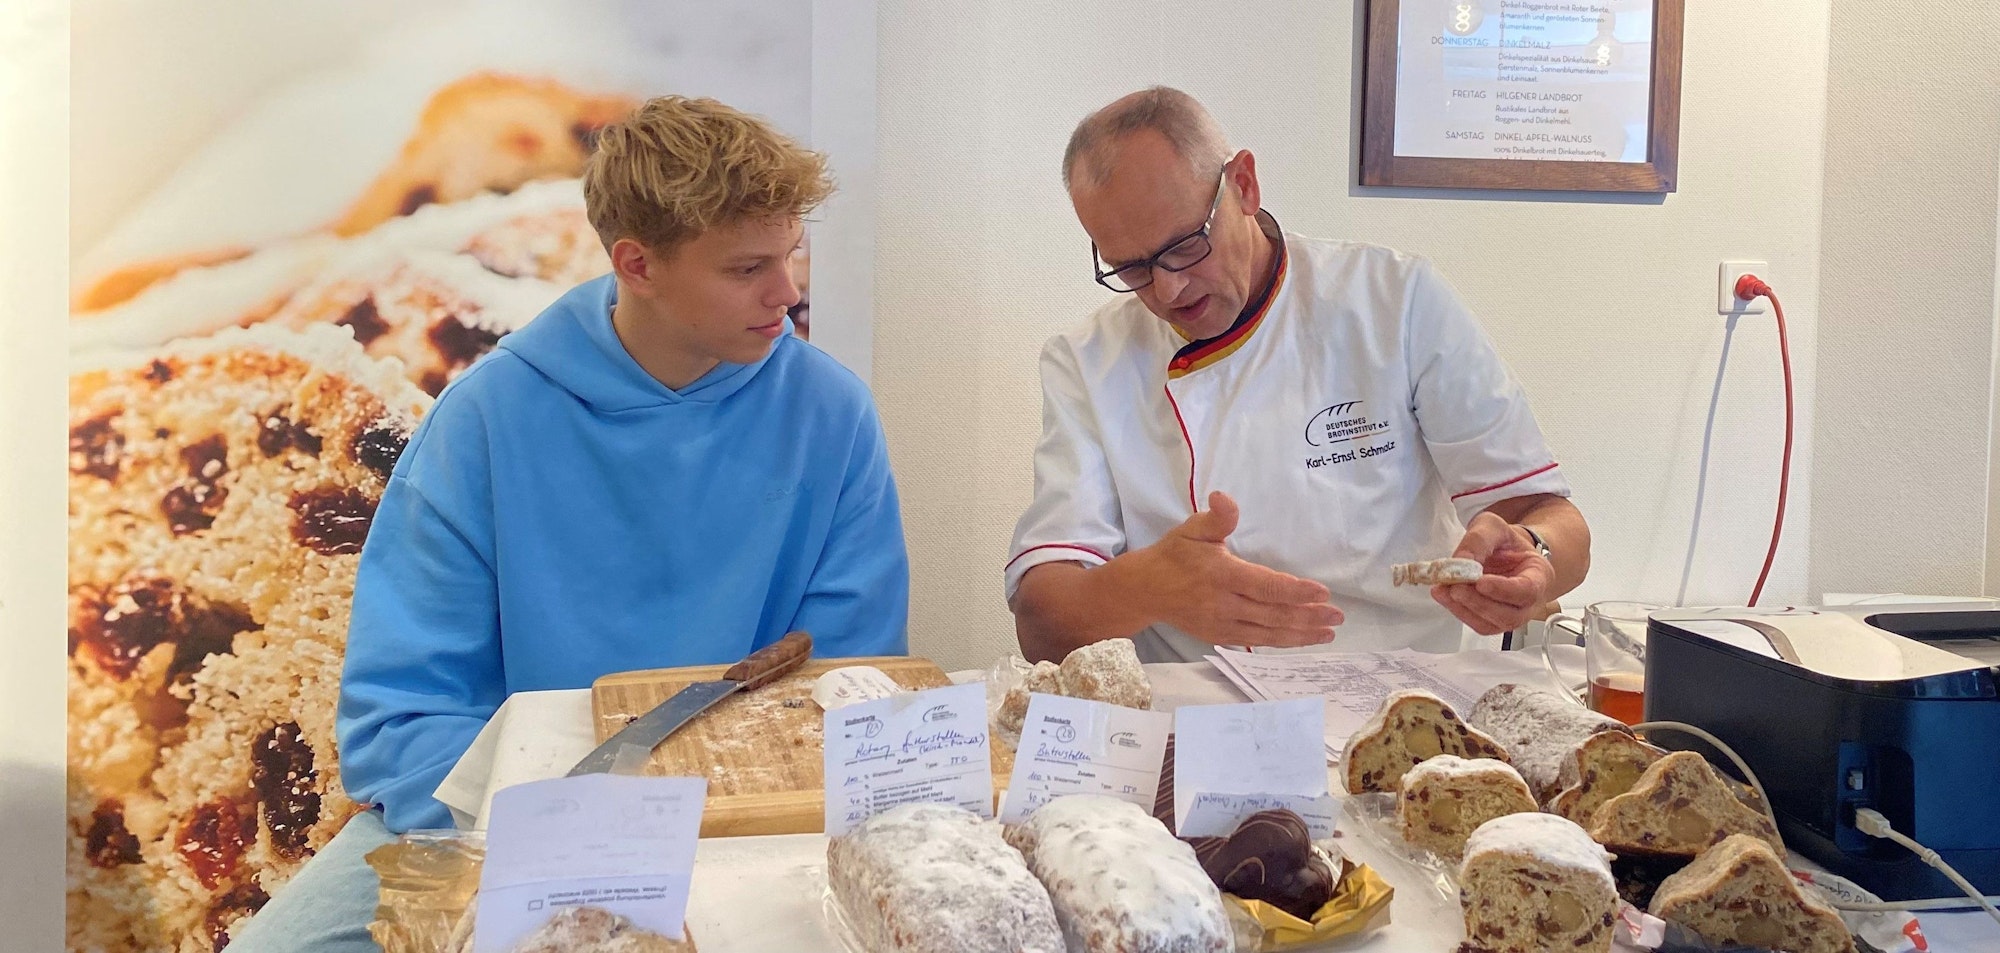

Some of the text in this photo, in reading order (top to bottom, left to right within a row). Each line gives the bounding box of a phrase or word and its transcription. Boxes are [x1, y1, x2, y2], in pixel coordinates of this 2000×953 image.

[1571, 4, 1589, 12] Roter
[1500, 11, 1531, 20] Amaranth
[1431, 36, 1489, 47] DONNERSTAG
[1499, 39, 1551, 49] DINKELMALZ
[1498, 53, 1549, 63] Dinkelspezialität
[1540, 65, 1609, 75] Sonnenblumenkernen
[1452, 89, 1487, 99] FREITAG
[1496, 92, 1583, 103] HILGENER LANDBROT
[1495, 105, 1527, 113] Rustikales
[1528, 106, 1557, 114] Landbrot
[1445, 131, 1485, 140] SAMSTAG
[1512, 146, 1545, 154] Dinkelbrot
[1326, 417, 1367, 430] DEUTSCHES
[1327, 423, 1377, 439] BROTINSTITUT
[1305, 441, 1396, 468] Karl-Ernst Schmalz
